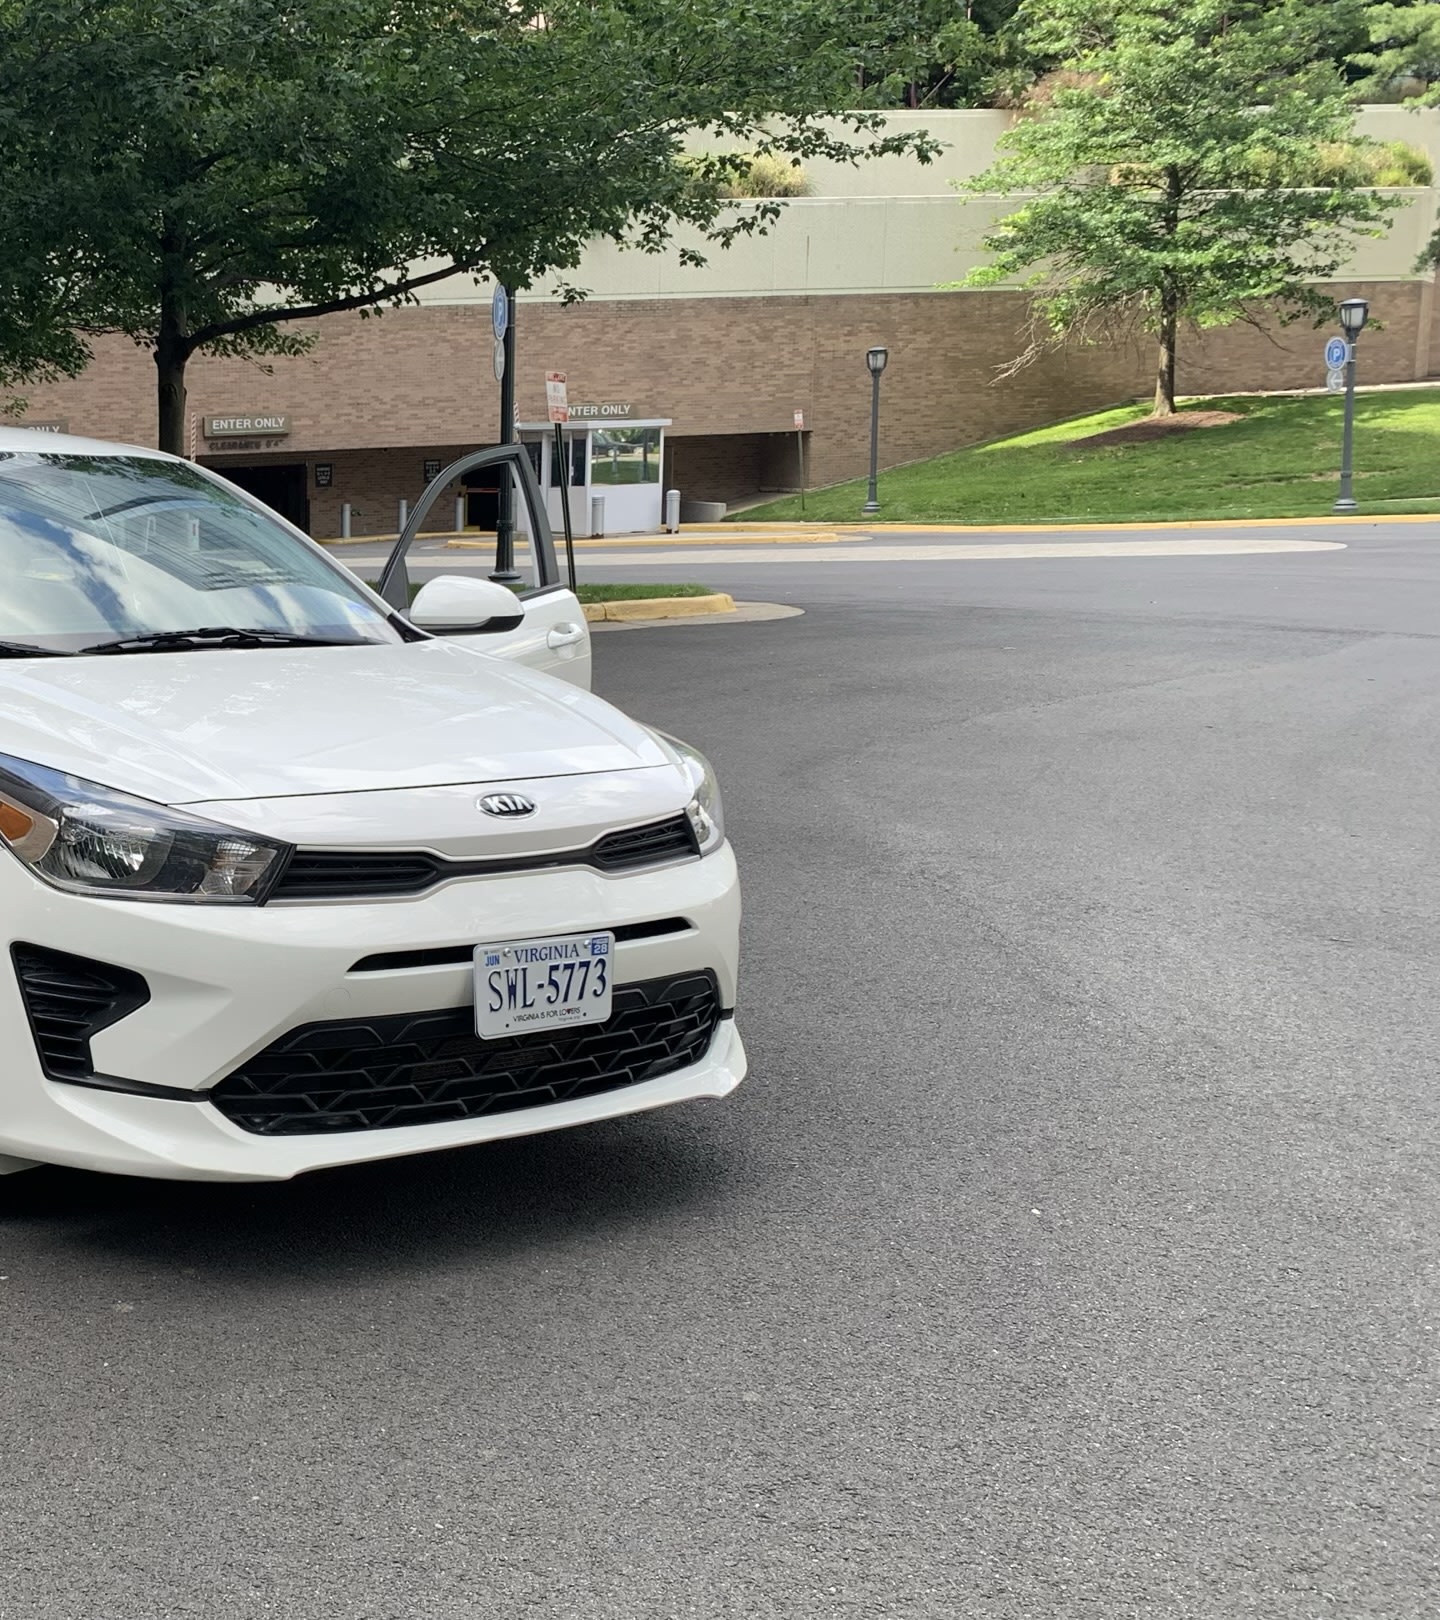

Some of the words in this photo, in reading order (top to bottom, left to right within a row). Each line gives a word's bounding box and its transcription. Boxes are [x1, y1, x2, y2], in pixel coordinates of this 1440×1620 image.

[568, 405, 599, 416] NTER
[601, 404, 631, 415] ONLY
[212, 418, 252, 430] ENTER
[254, 417, 285, 428] ONLY
[483, 795, 533, 813] KIA
[513, 943, 580, 963] VIRGINIA
[593, 943, 608, 955] 28
[485, 954, 500, 967] JUN
[488, 958, 607, 1013] SWL-5773
[512, 1013, 540, 1022] VIRGINIA
[546, 1009, 558, 1018] FOR
